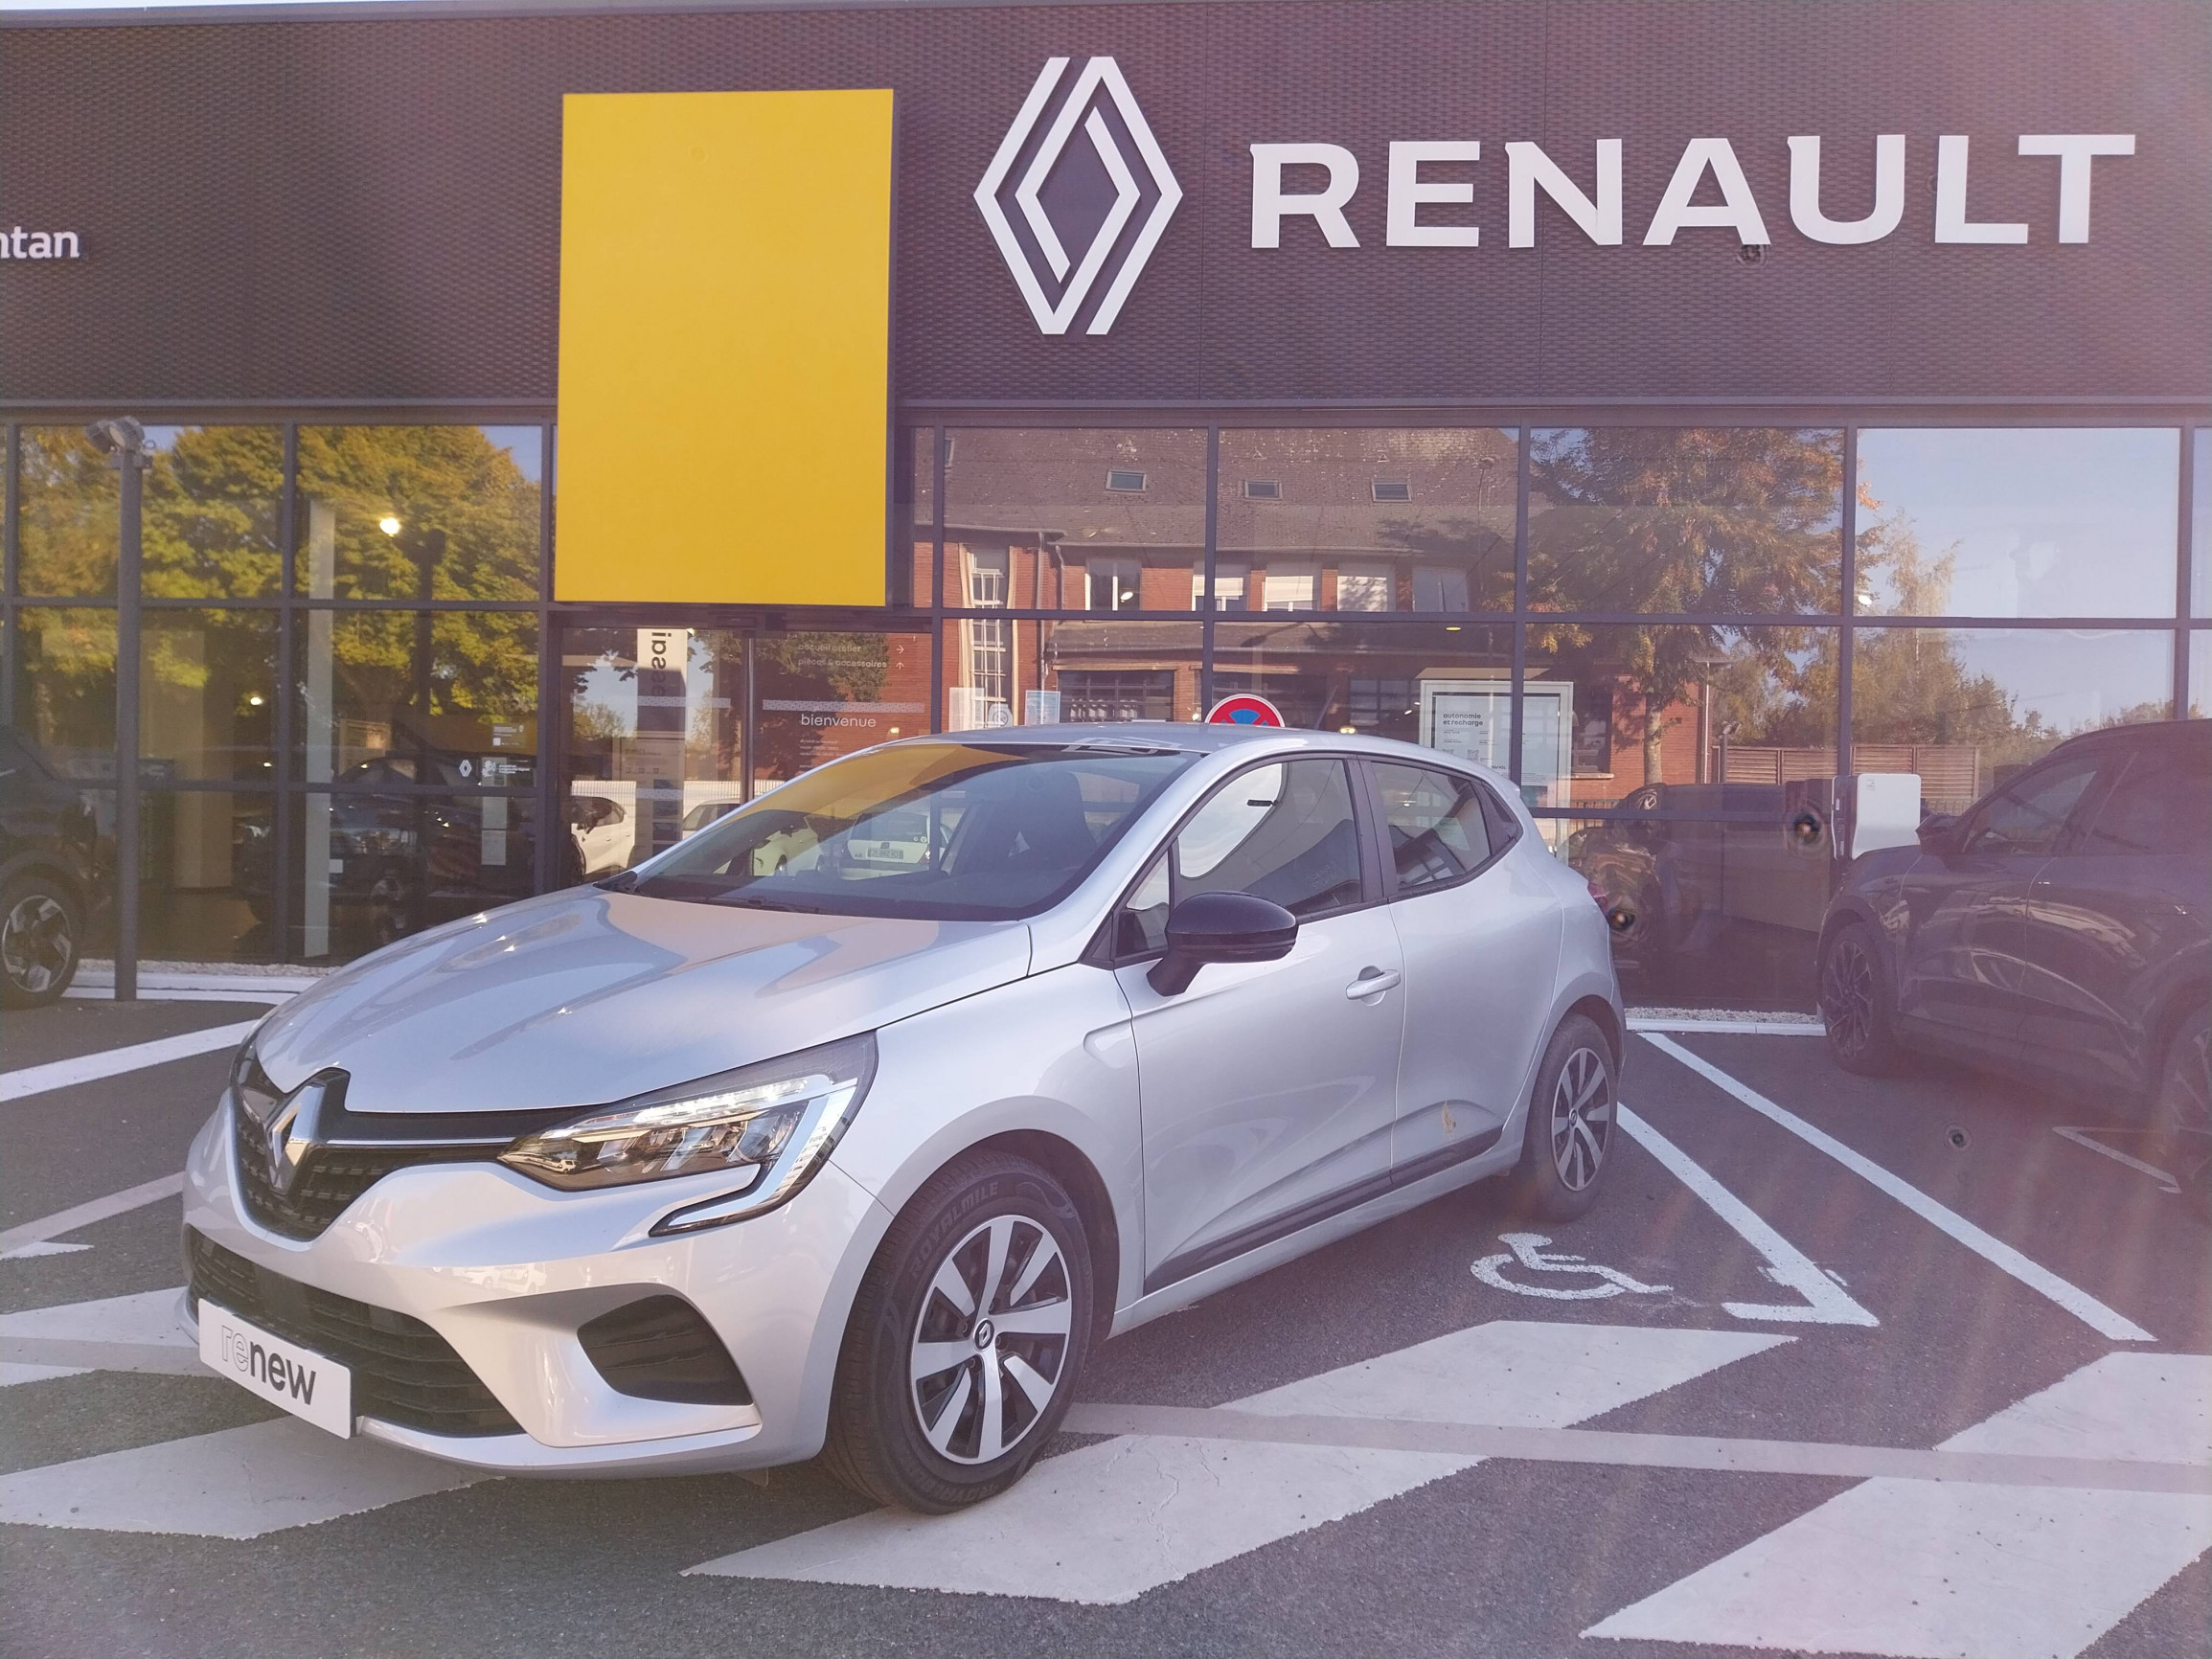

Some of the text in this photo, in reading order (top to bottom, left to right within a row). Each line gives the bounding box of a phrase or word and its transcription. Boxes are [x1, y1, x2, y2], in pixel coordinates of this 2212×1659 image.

[1249, 134, 2136, 248] RENAULT
[801, 713, 877, 728] bienvenue
[221, 1326, 317, 1405] renew
